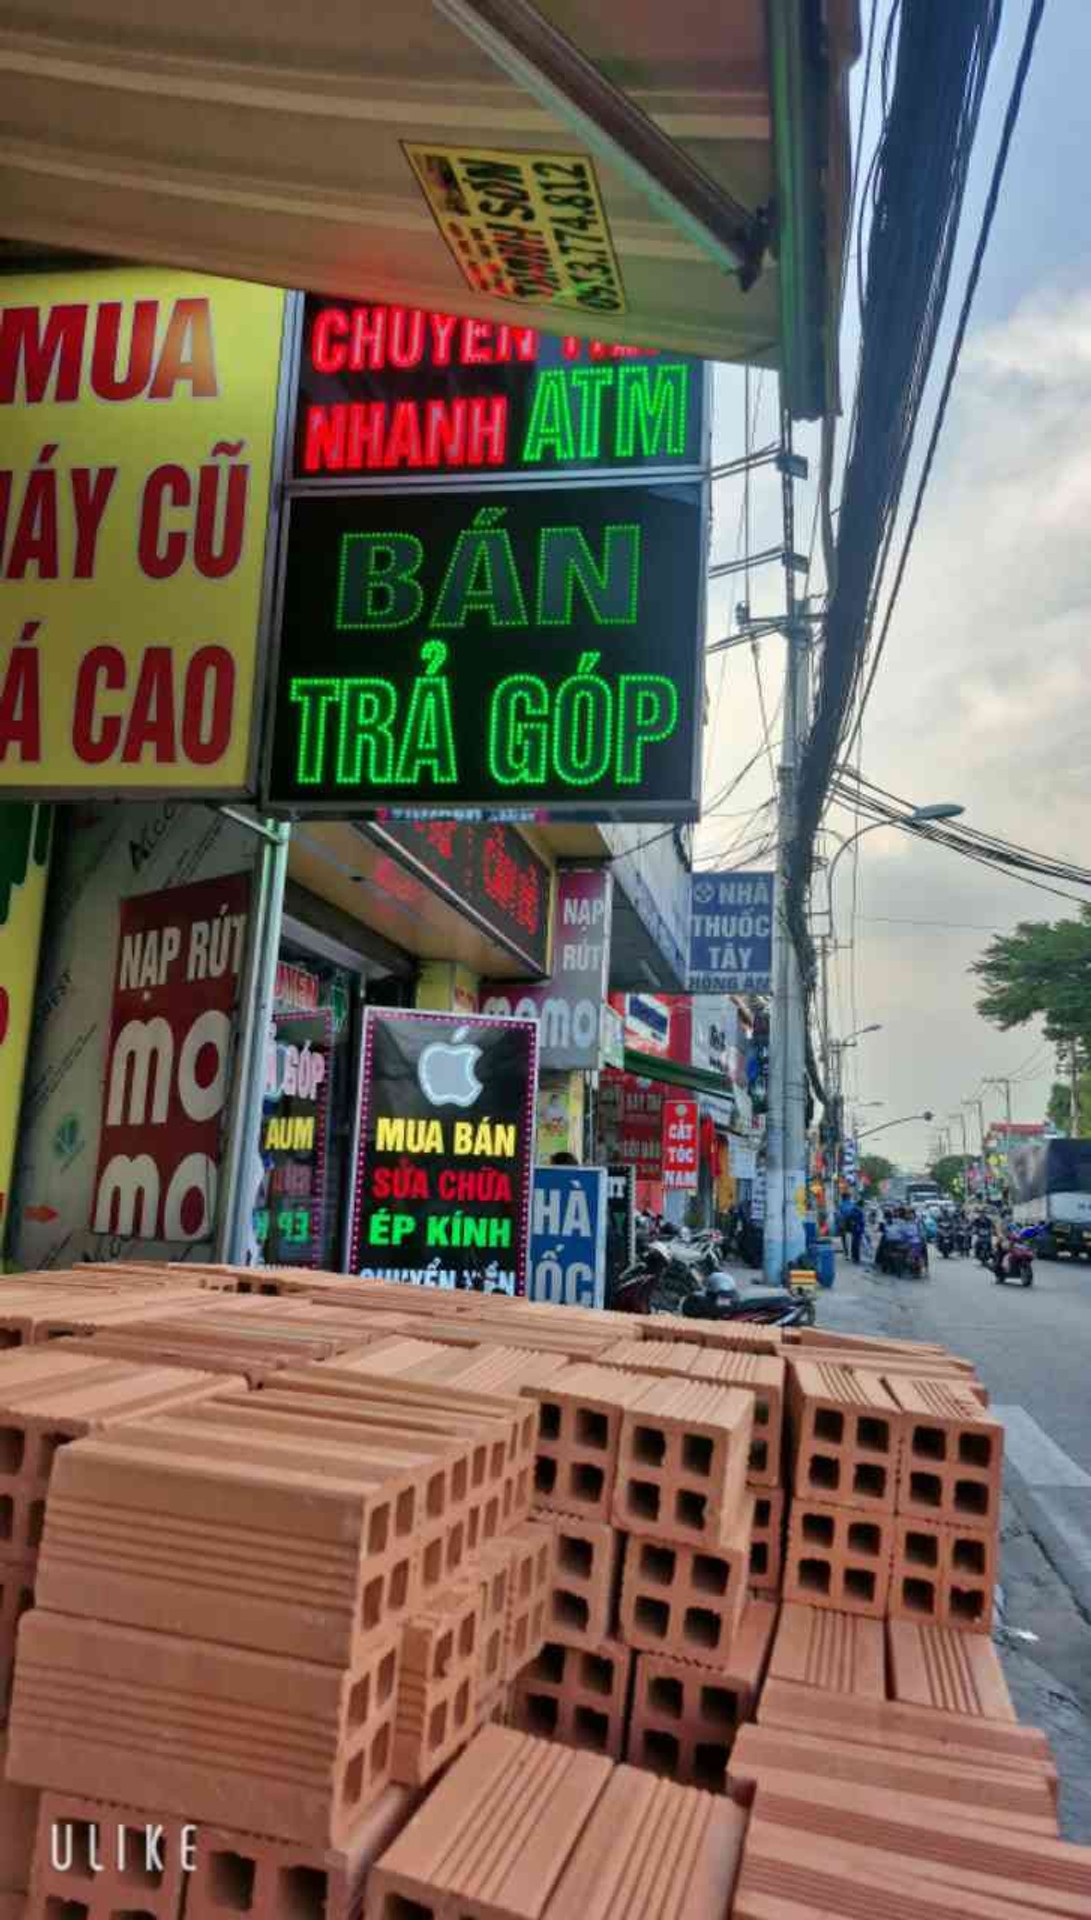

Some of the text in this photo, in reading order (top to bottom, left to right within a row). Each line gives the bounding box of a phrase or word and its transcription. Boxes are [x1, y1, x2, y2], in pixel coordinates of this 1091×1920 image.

[0, 298, 217, 404] MUA
[305, 364, 689, 471] NHANH ATM
[0, 440, 249, 580] ÁY CŨ
[336, 506, 641, 629] BÁN
[72, 644, 236, 765] CAO
[290, 639, 679, 784] TRẢ GÓP
[563, 897, 602, 934] NẠP
[692, 906, 770, 938] THUỐC
[718, 875, 769, 905] NHÀ
[120, 926, 181, 1001] NẠP
[187, 904, 247, 981] RÚT
[562, 937, 600, 971] RÚT
[708, 942, 752, 970] TÂY
[106, 1010, 230, 1126] mo
[375, 1116, 516, 1157] MUA BÁN
[94, 1152, 218, 1242] mo
[372, 1155, 513, 1202] SỬA CHỮA
[369, 1207, 512, 1248] ÉP KÍNH
[528, 1243, 593, 1306] ỐC
